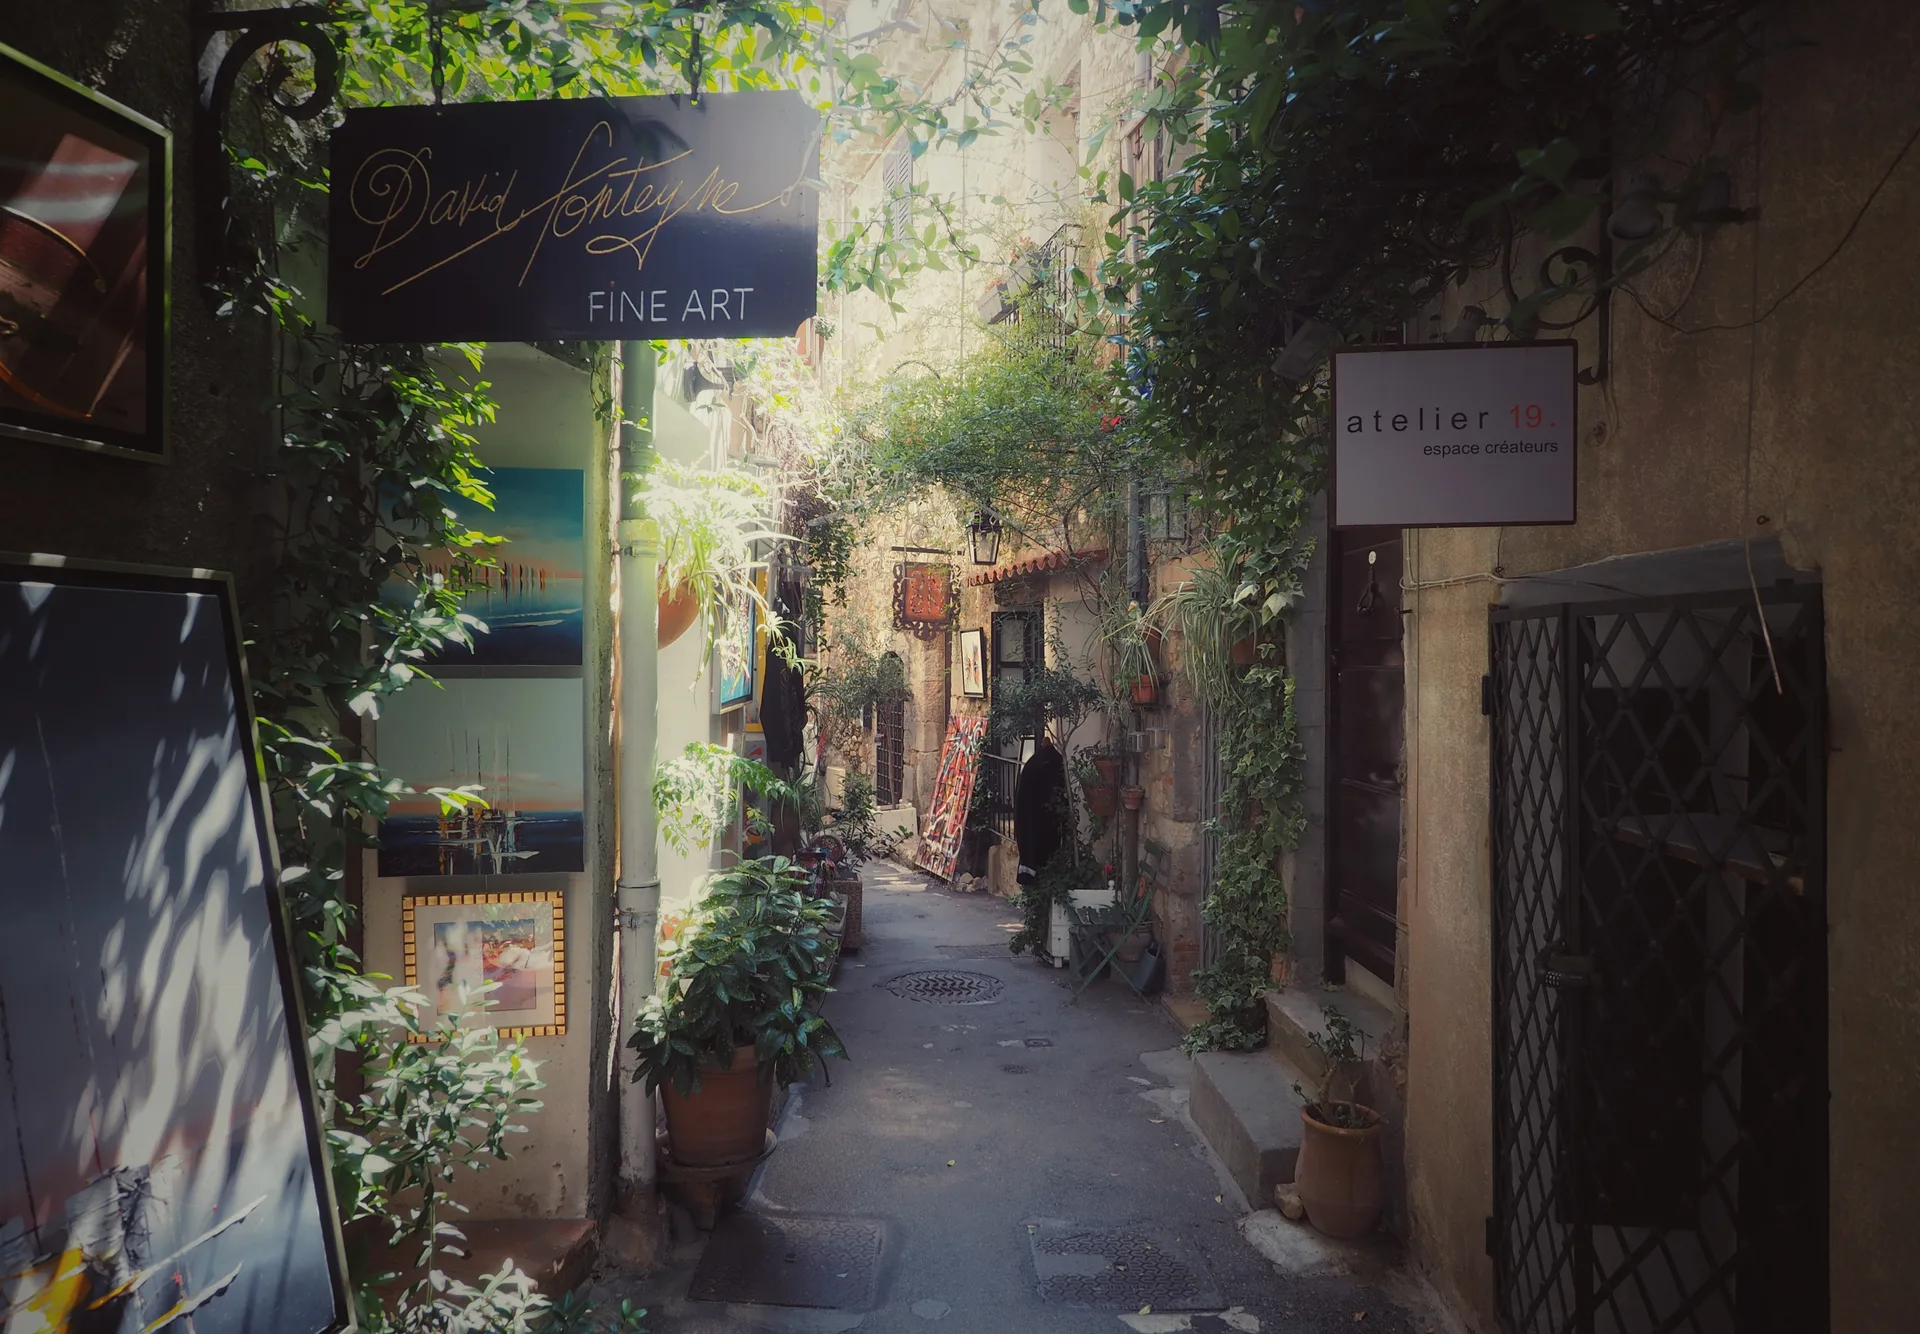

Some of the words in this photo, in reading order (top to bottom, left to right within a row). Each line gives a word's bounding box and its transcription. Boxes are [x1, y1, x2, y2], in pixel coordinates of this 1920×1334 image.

[350, 146, 524, 295] David
[589, 282, 668, 323] FINE
[681, 287, 755, 322] ART
[1347, 407, 1490, 434] atelier
[1510, 403, 1556, 429] 19.
[1423, 442, 1480, 458] espace
[1485, 440, 1559, 455] créateurs
